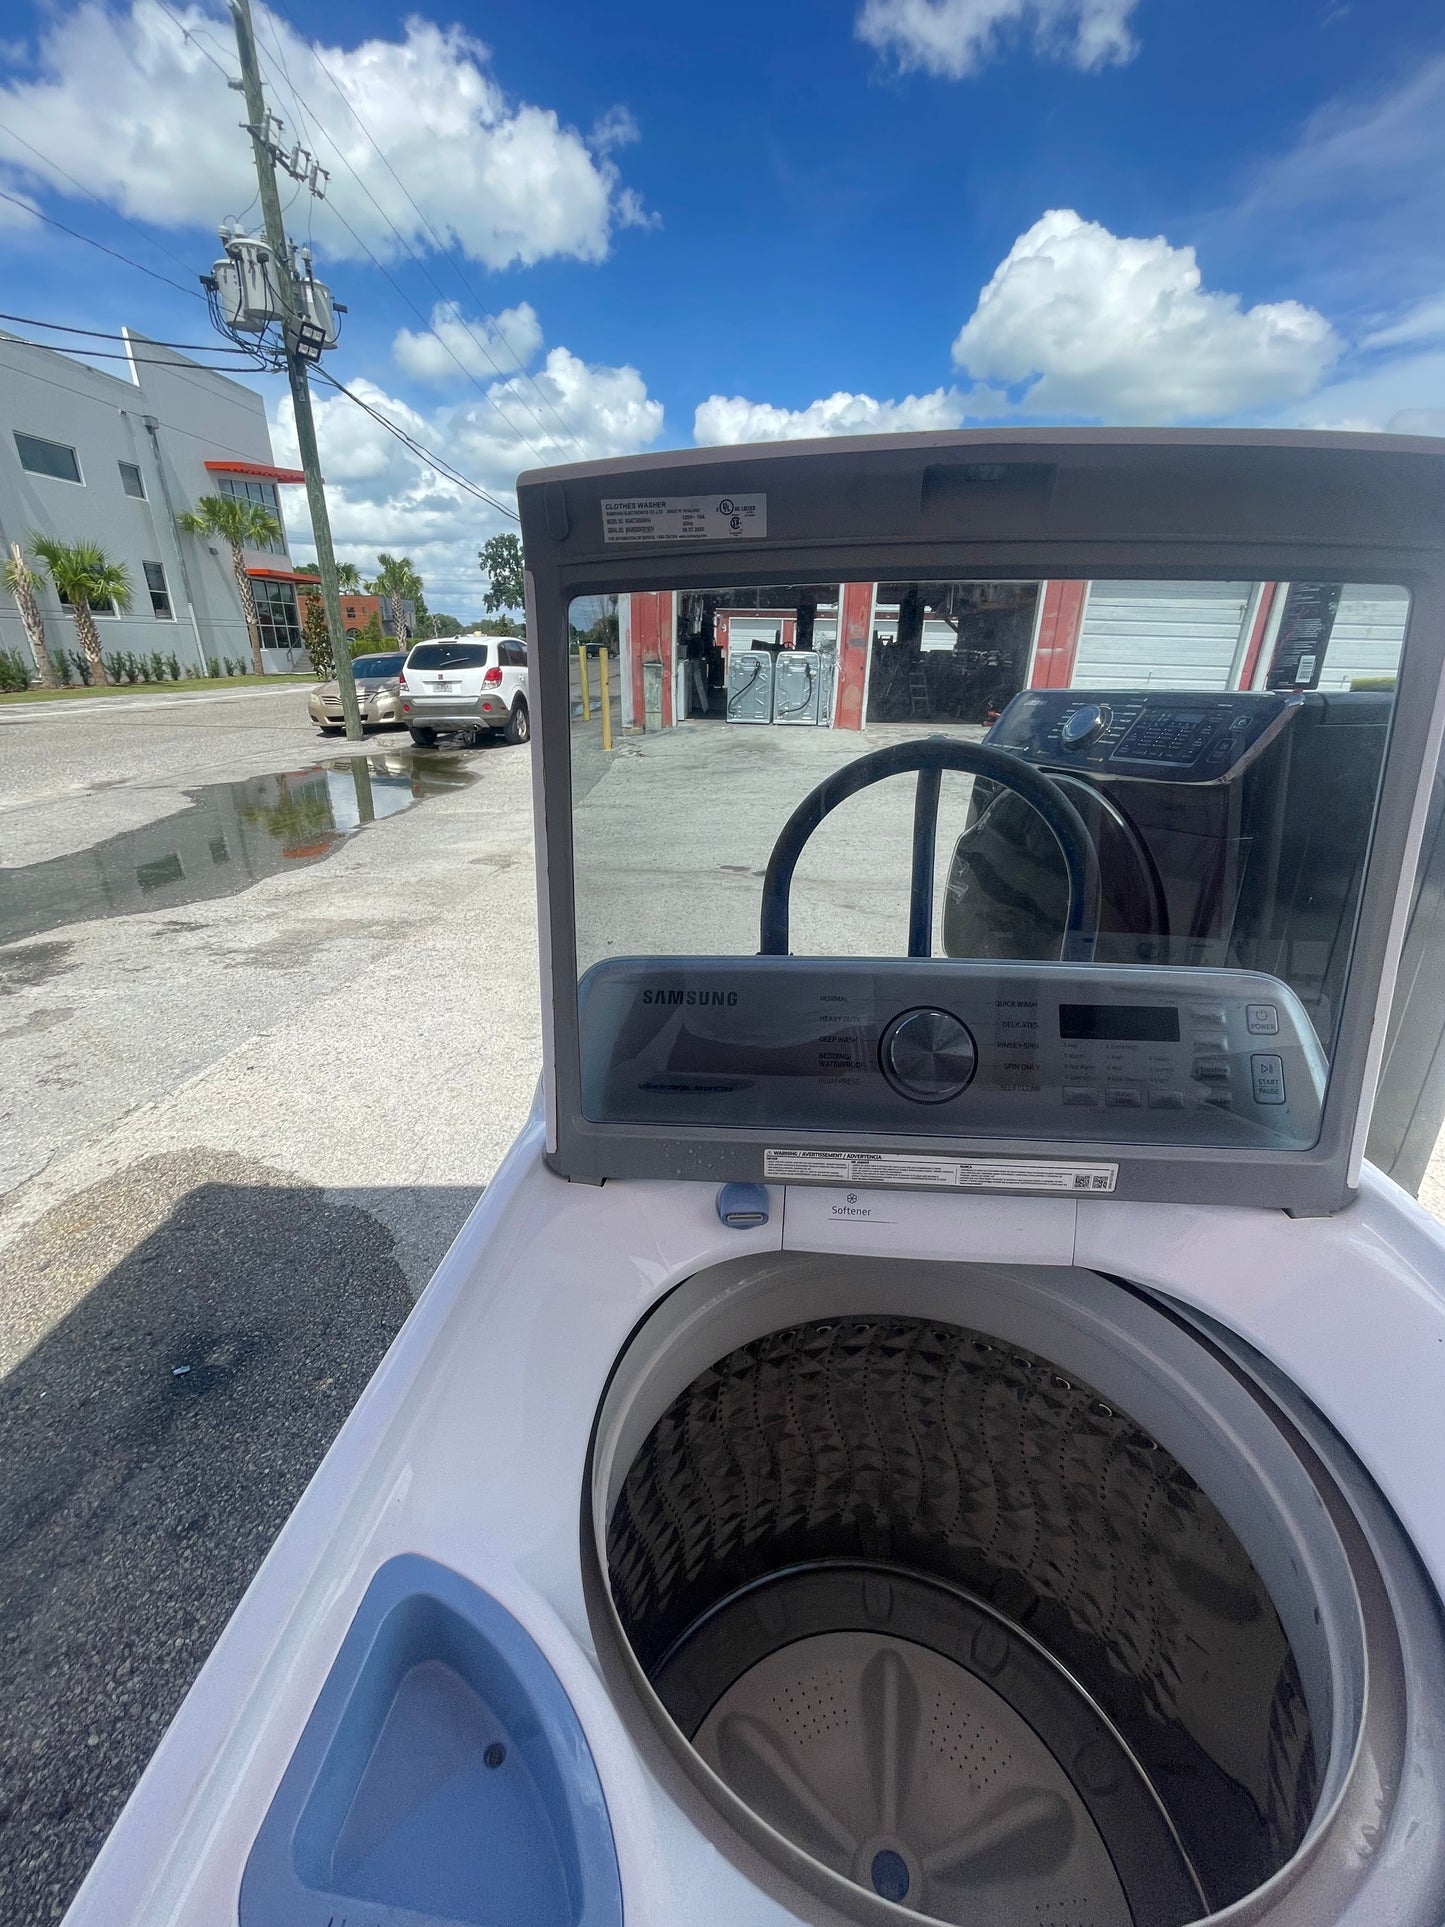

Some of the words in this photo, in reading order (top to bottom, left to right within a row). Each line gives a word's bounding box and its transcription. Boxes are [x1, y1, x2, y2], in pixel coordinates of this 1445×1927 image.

[605, 502, 636, 510] CLOTHES
[637, 501, 667, 509] WASHER
[642, 989, 738, 1006] SAMSUNG
[994, 1000, 1016, 1008] QUICK
[1016, 1000, 1038, 1008] WASH
[1001, 1021, 1040, 1029] DELICATES
[819, 1035, 837, 1043] DEEP
[996, 1041, 1017, 1049] RINSE
[818, 1060, 865, 1069] WATERPROOF
[1003, 1063, 1020, 1071] SPIN
[1020, 1063, 1040, 1071] ONLY
[838, 1078, 861, 1086] PRESS
[832, 1205, 872, 1216] Softener
